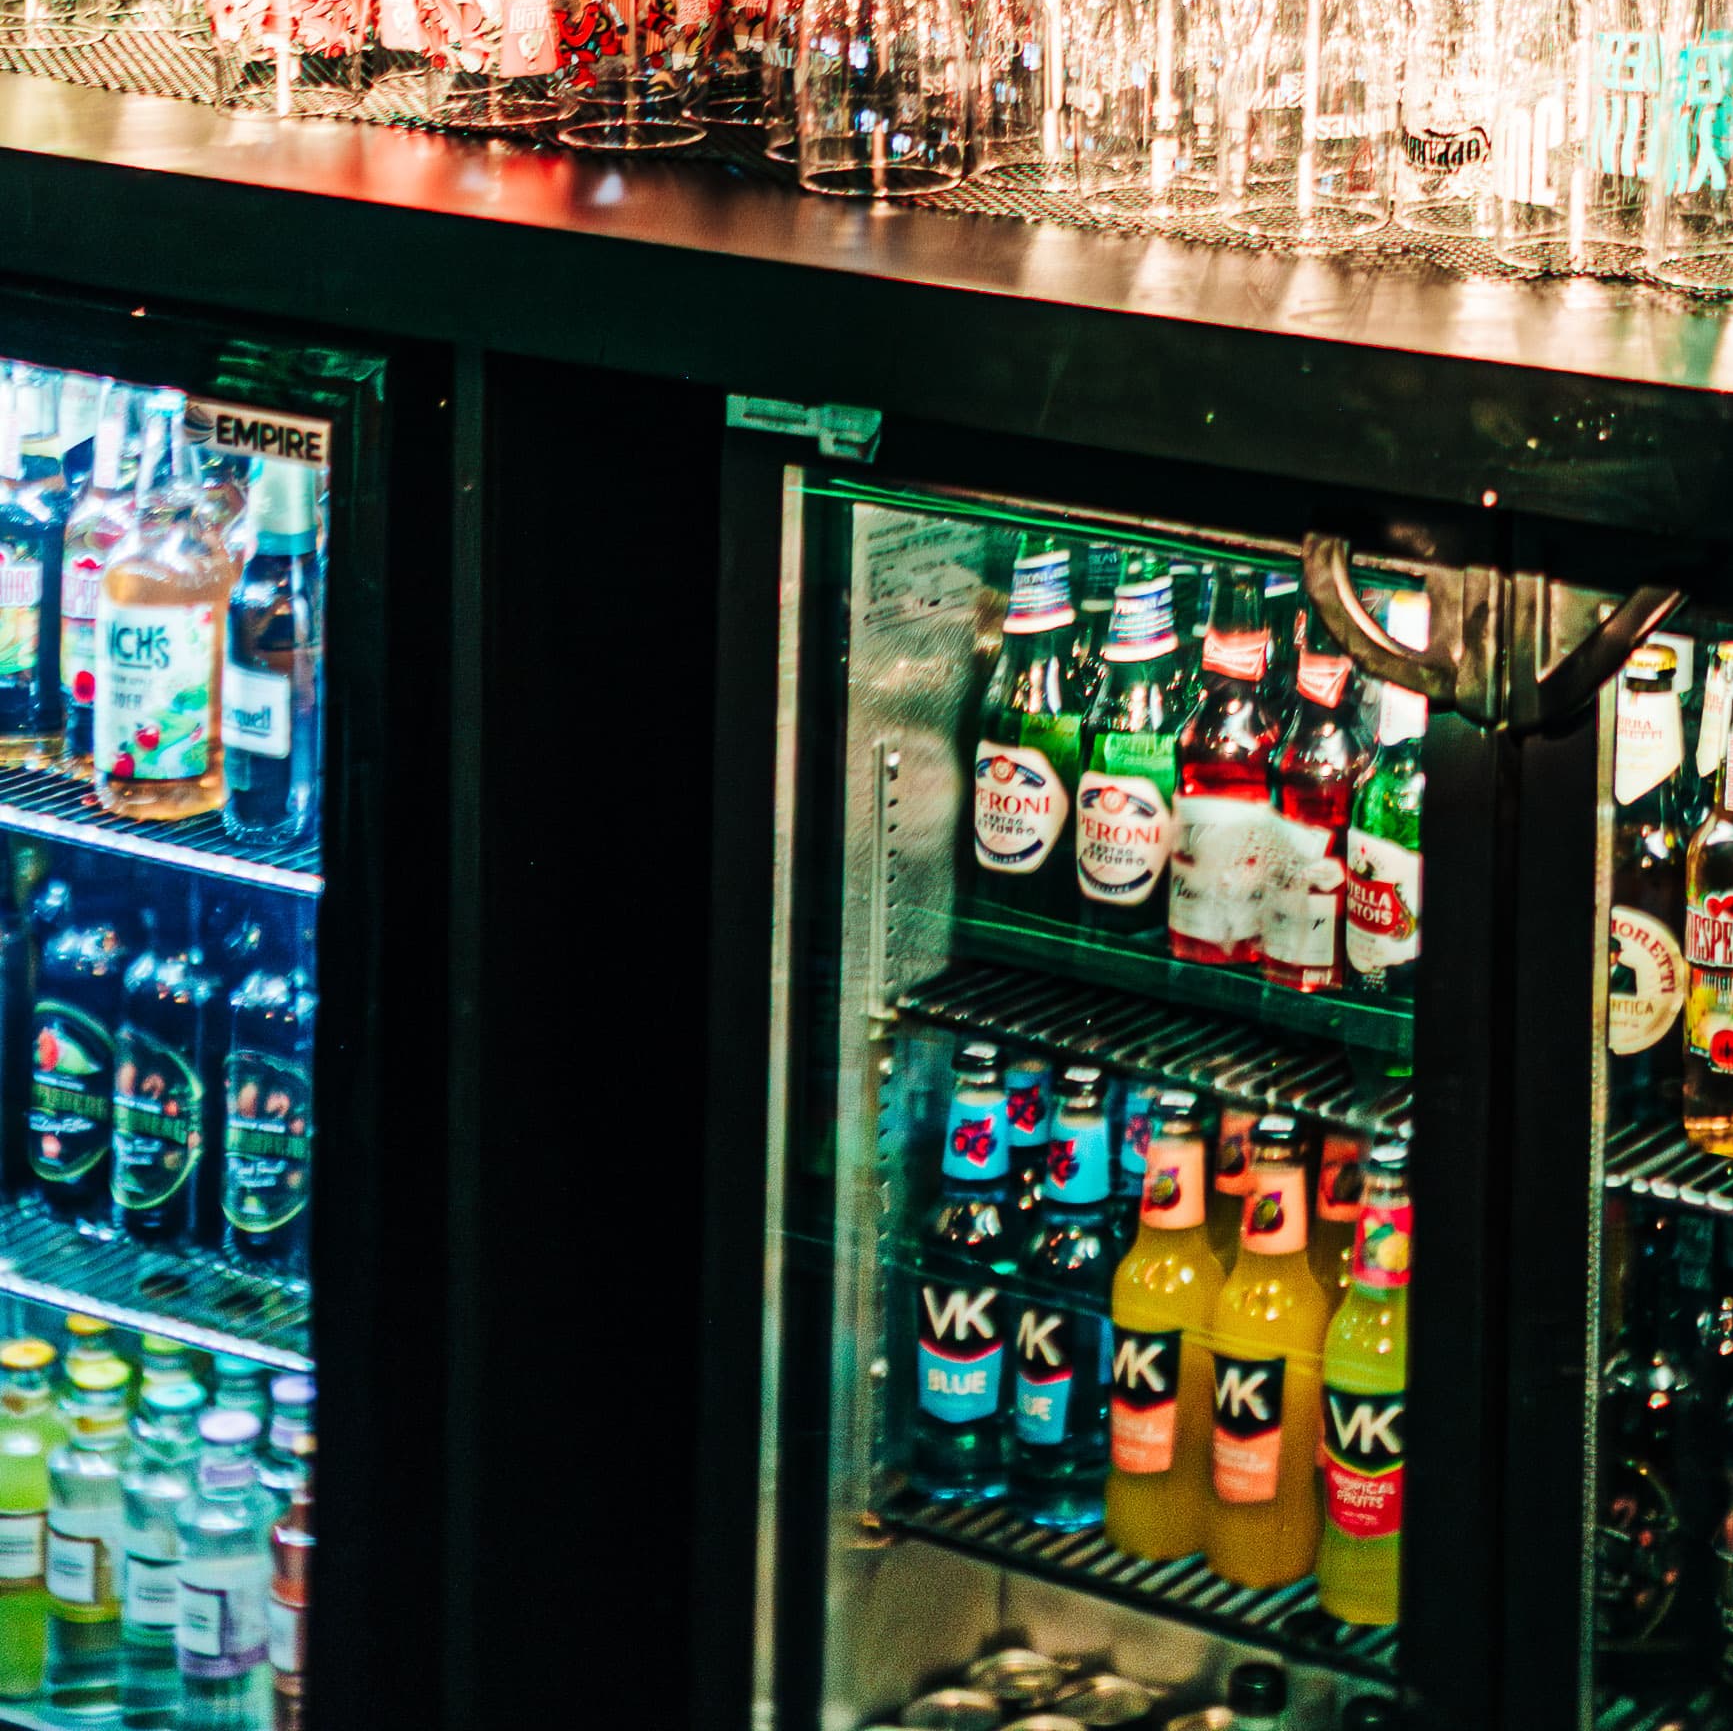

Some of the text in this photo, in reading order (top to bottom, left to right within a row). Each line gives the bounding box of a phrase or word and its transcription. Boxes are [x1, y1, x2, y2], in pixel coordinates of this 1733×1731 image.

[217, 415, 323, 462] EMPIRE
[922, 1287, 999, 1341] VK
[928, 1369, 987, 1397] BLUE
[1216, 1368, 1271, 1420] VK
[1329, 1402, 1404, 1454] VK
